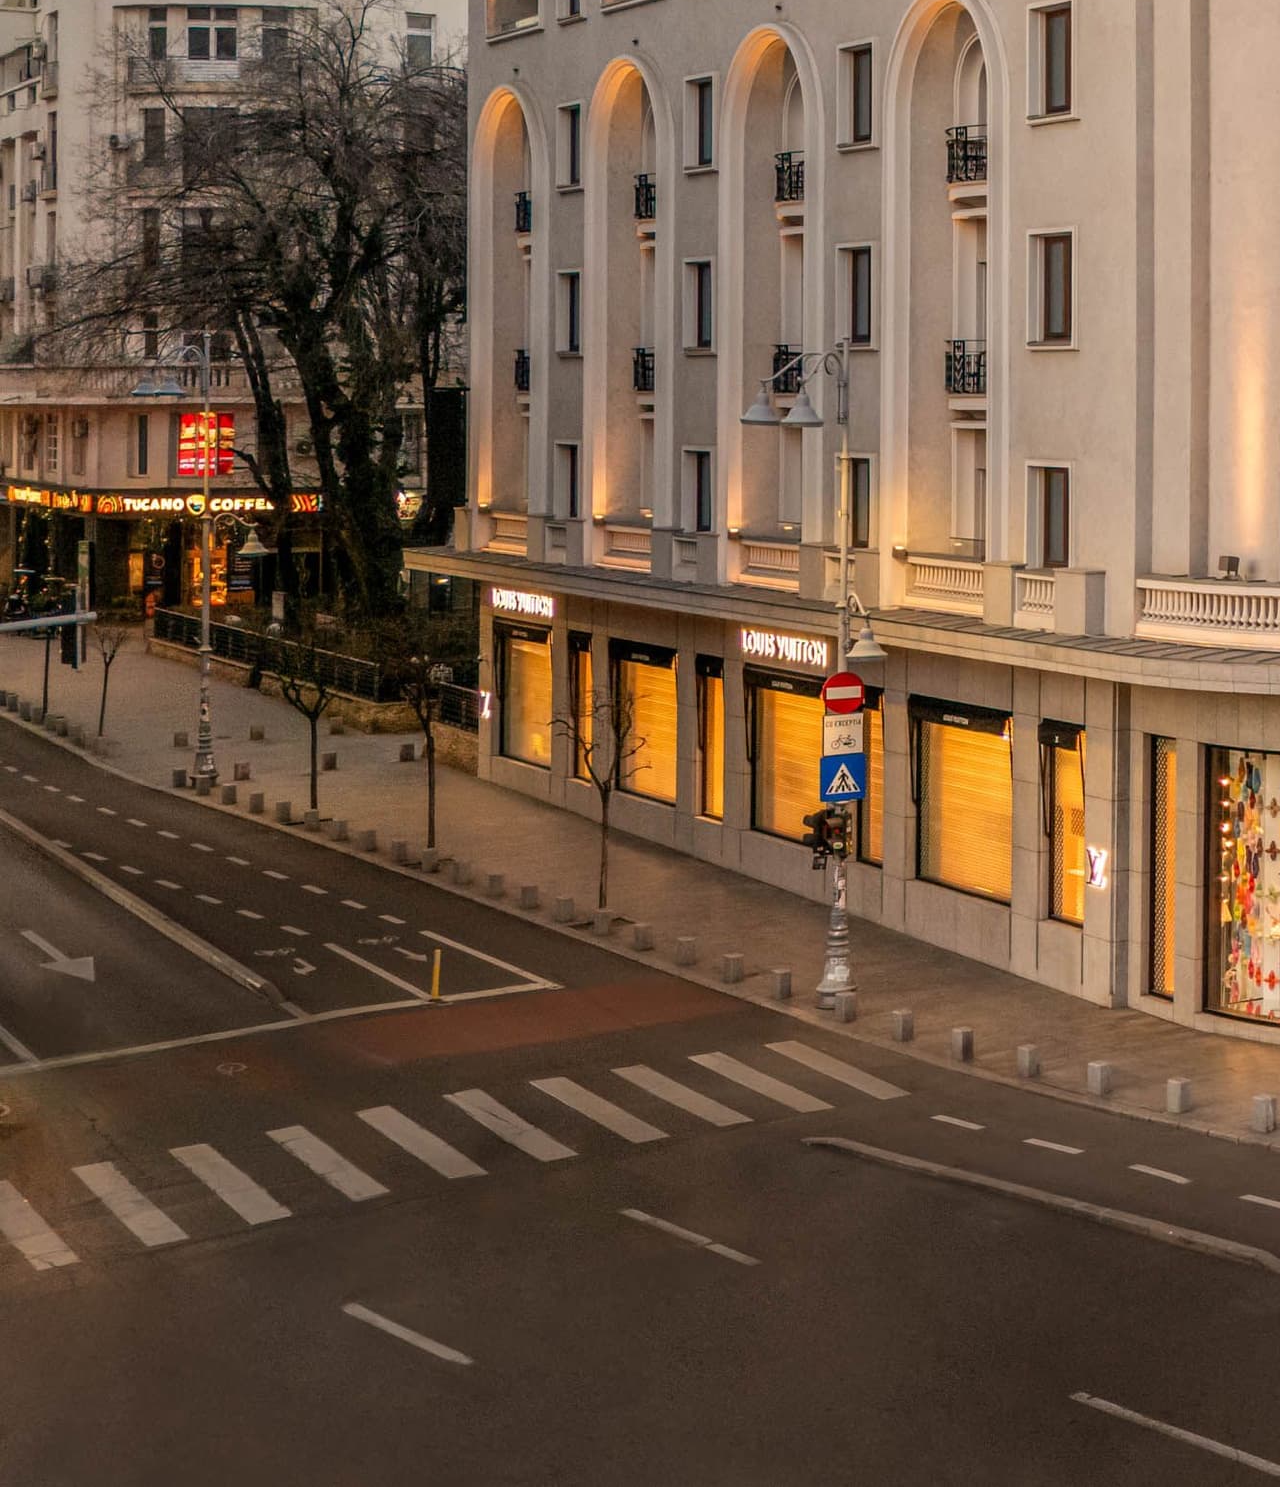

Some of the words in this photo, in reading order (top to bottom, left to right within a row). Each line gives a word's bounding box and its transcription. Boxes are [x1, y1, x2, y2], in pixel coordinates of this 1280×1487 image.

[123, 497, 185, 512] TUCANO
[742, 628, 775, 658] LOUIS
[776, 634, 828, 669] VUITTON
